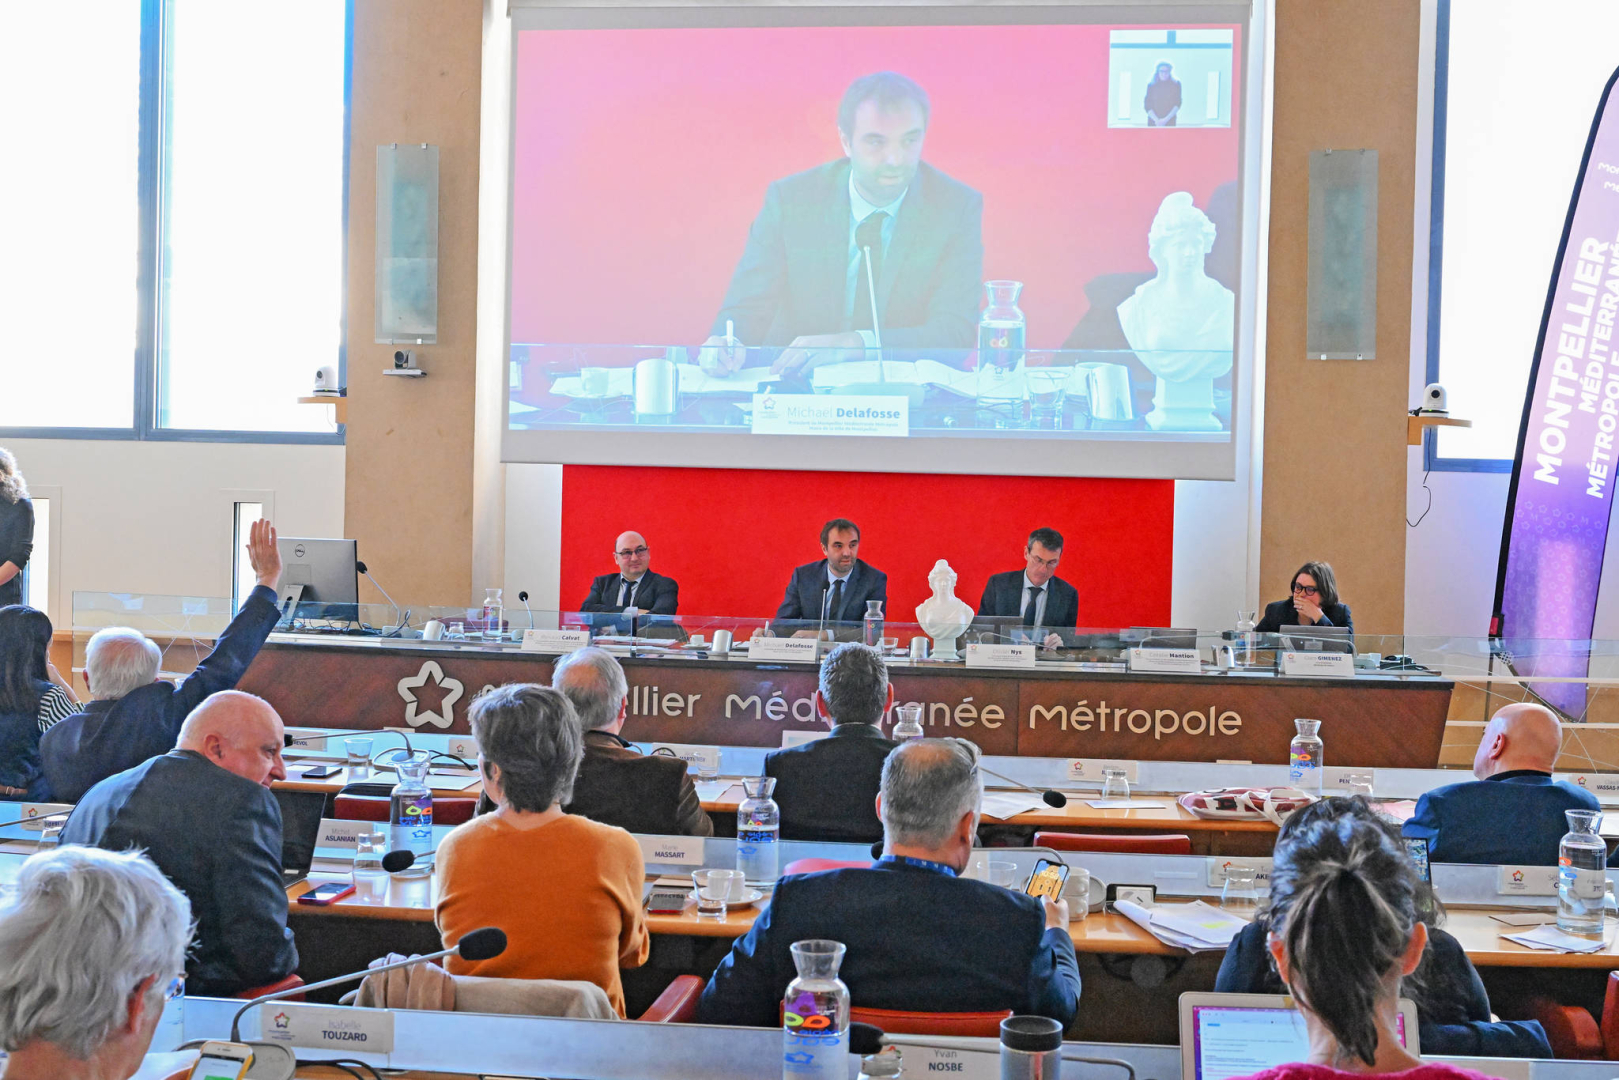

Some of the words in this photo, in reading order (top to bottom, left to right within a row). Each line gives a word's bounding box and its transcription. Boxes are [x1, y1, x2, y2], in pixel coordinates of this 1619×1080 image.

[1533, 237, 1610, 486] MONTPELLIER
[836, 407, 901, 419] Delafosse
[725, 689, 1005, 729] Médranée
[1029, 700, 1242, 740] Métropole
[325, 835, 356, 843] ASLANIAN
[654, 851, 686, 859] MASSART
[321, 1030, 368, 1042] TOUZARD
[933, 1049, 958, 1058] Yvan
[928, 1062, 964, 1072] NOSBE
